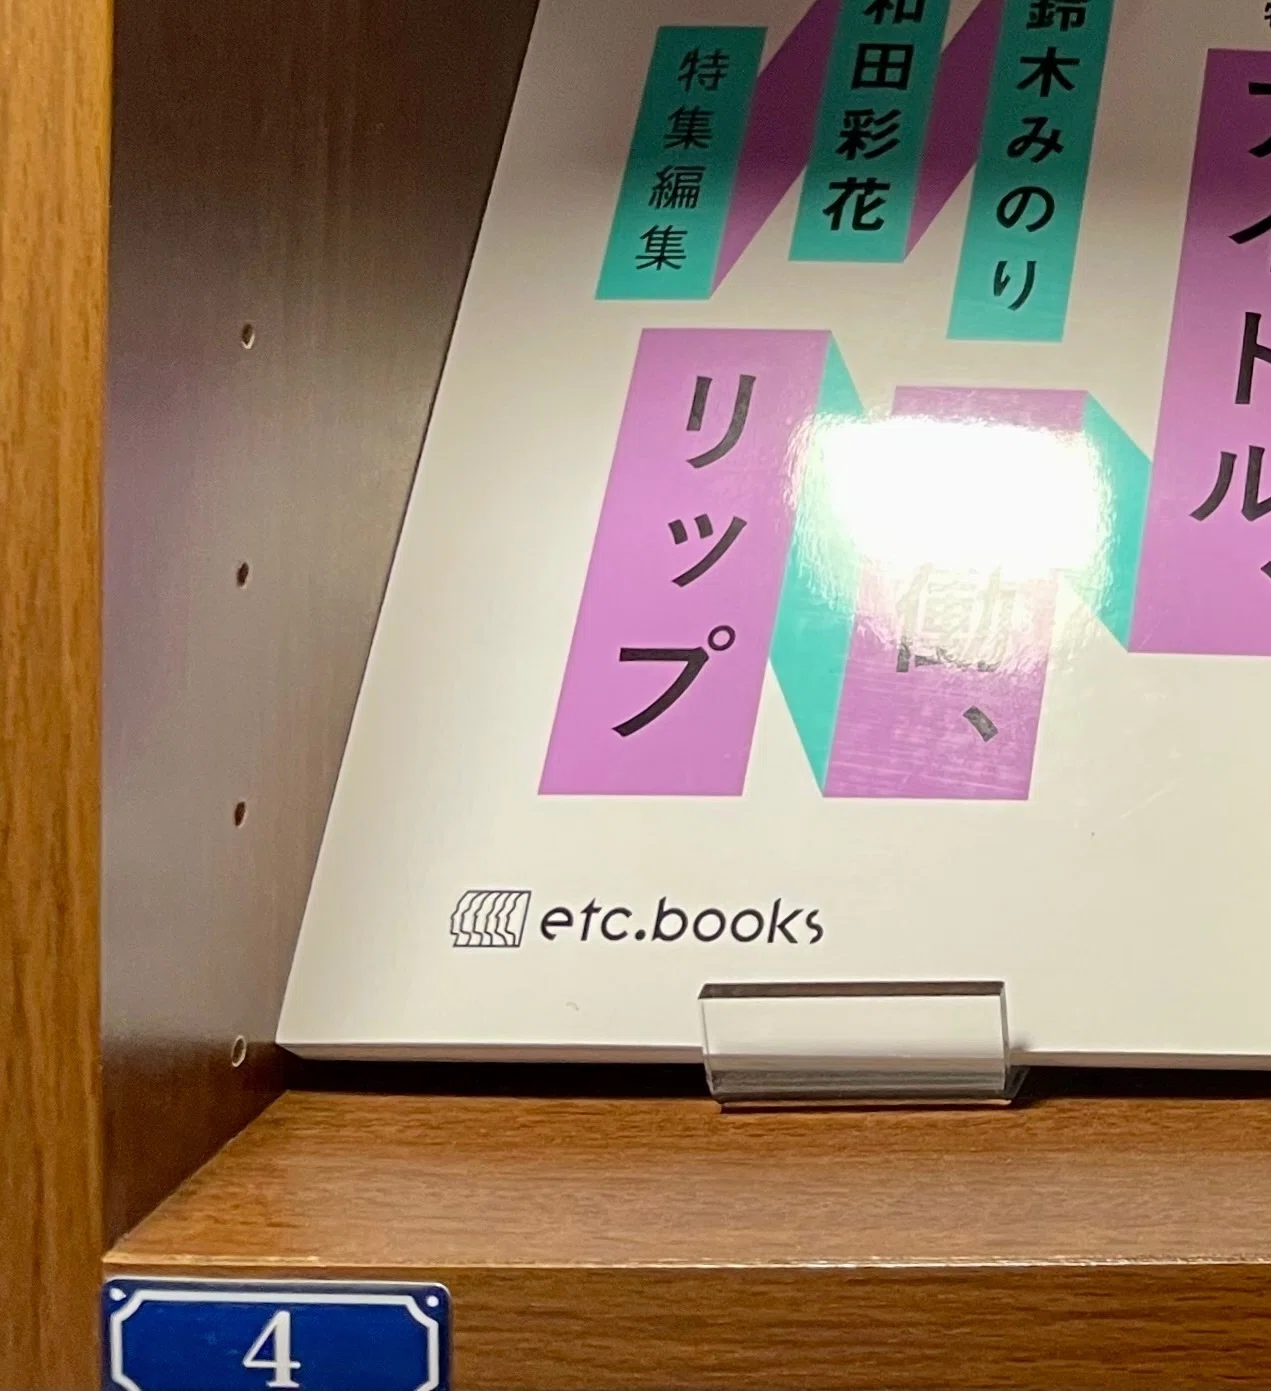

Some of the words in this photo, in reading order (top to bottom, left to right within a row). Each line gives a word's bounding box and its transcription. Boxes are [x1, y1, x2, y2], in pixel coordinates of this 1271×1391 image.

[634, 45, 731, 273] 特集編集
[610, 373, 757, 737] リップ
[538, 895, 825, 946] etc.books
[242, 1310, 302, 1388] 4
